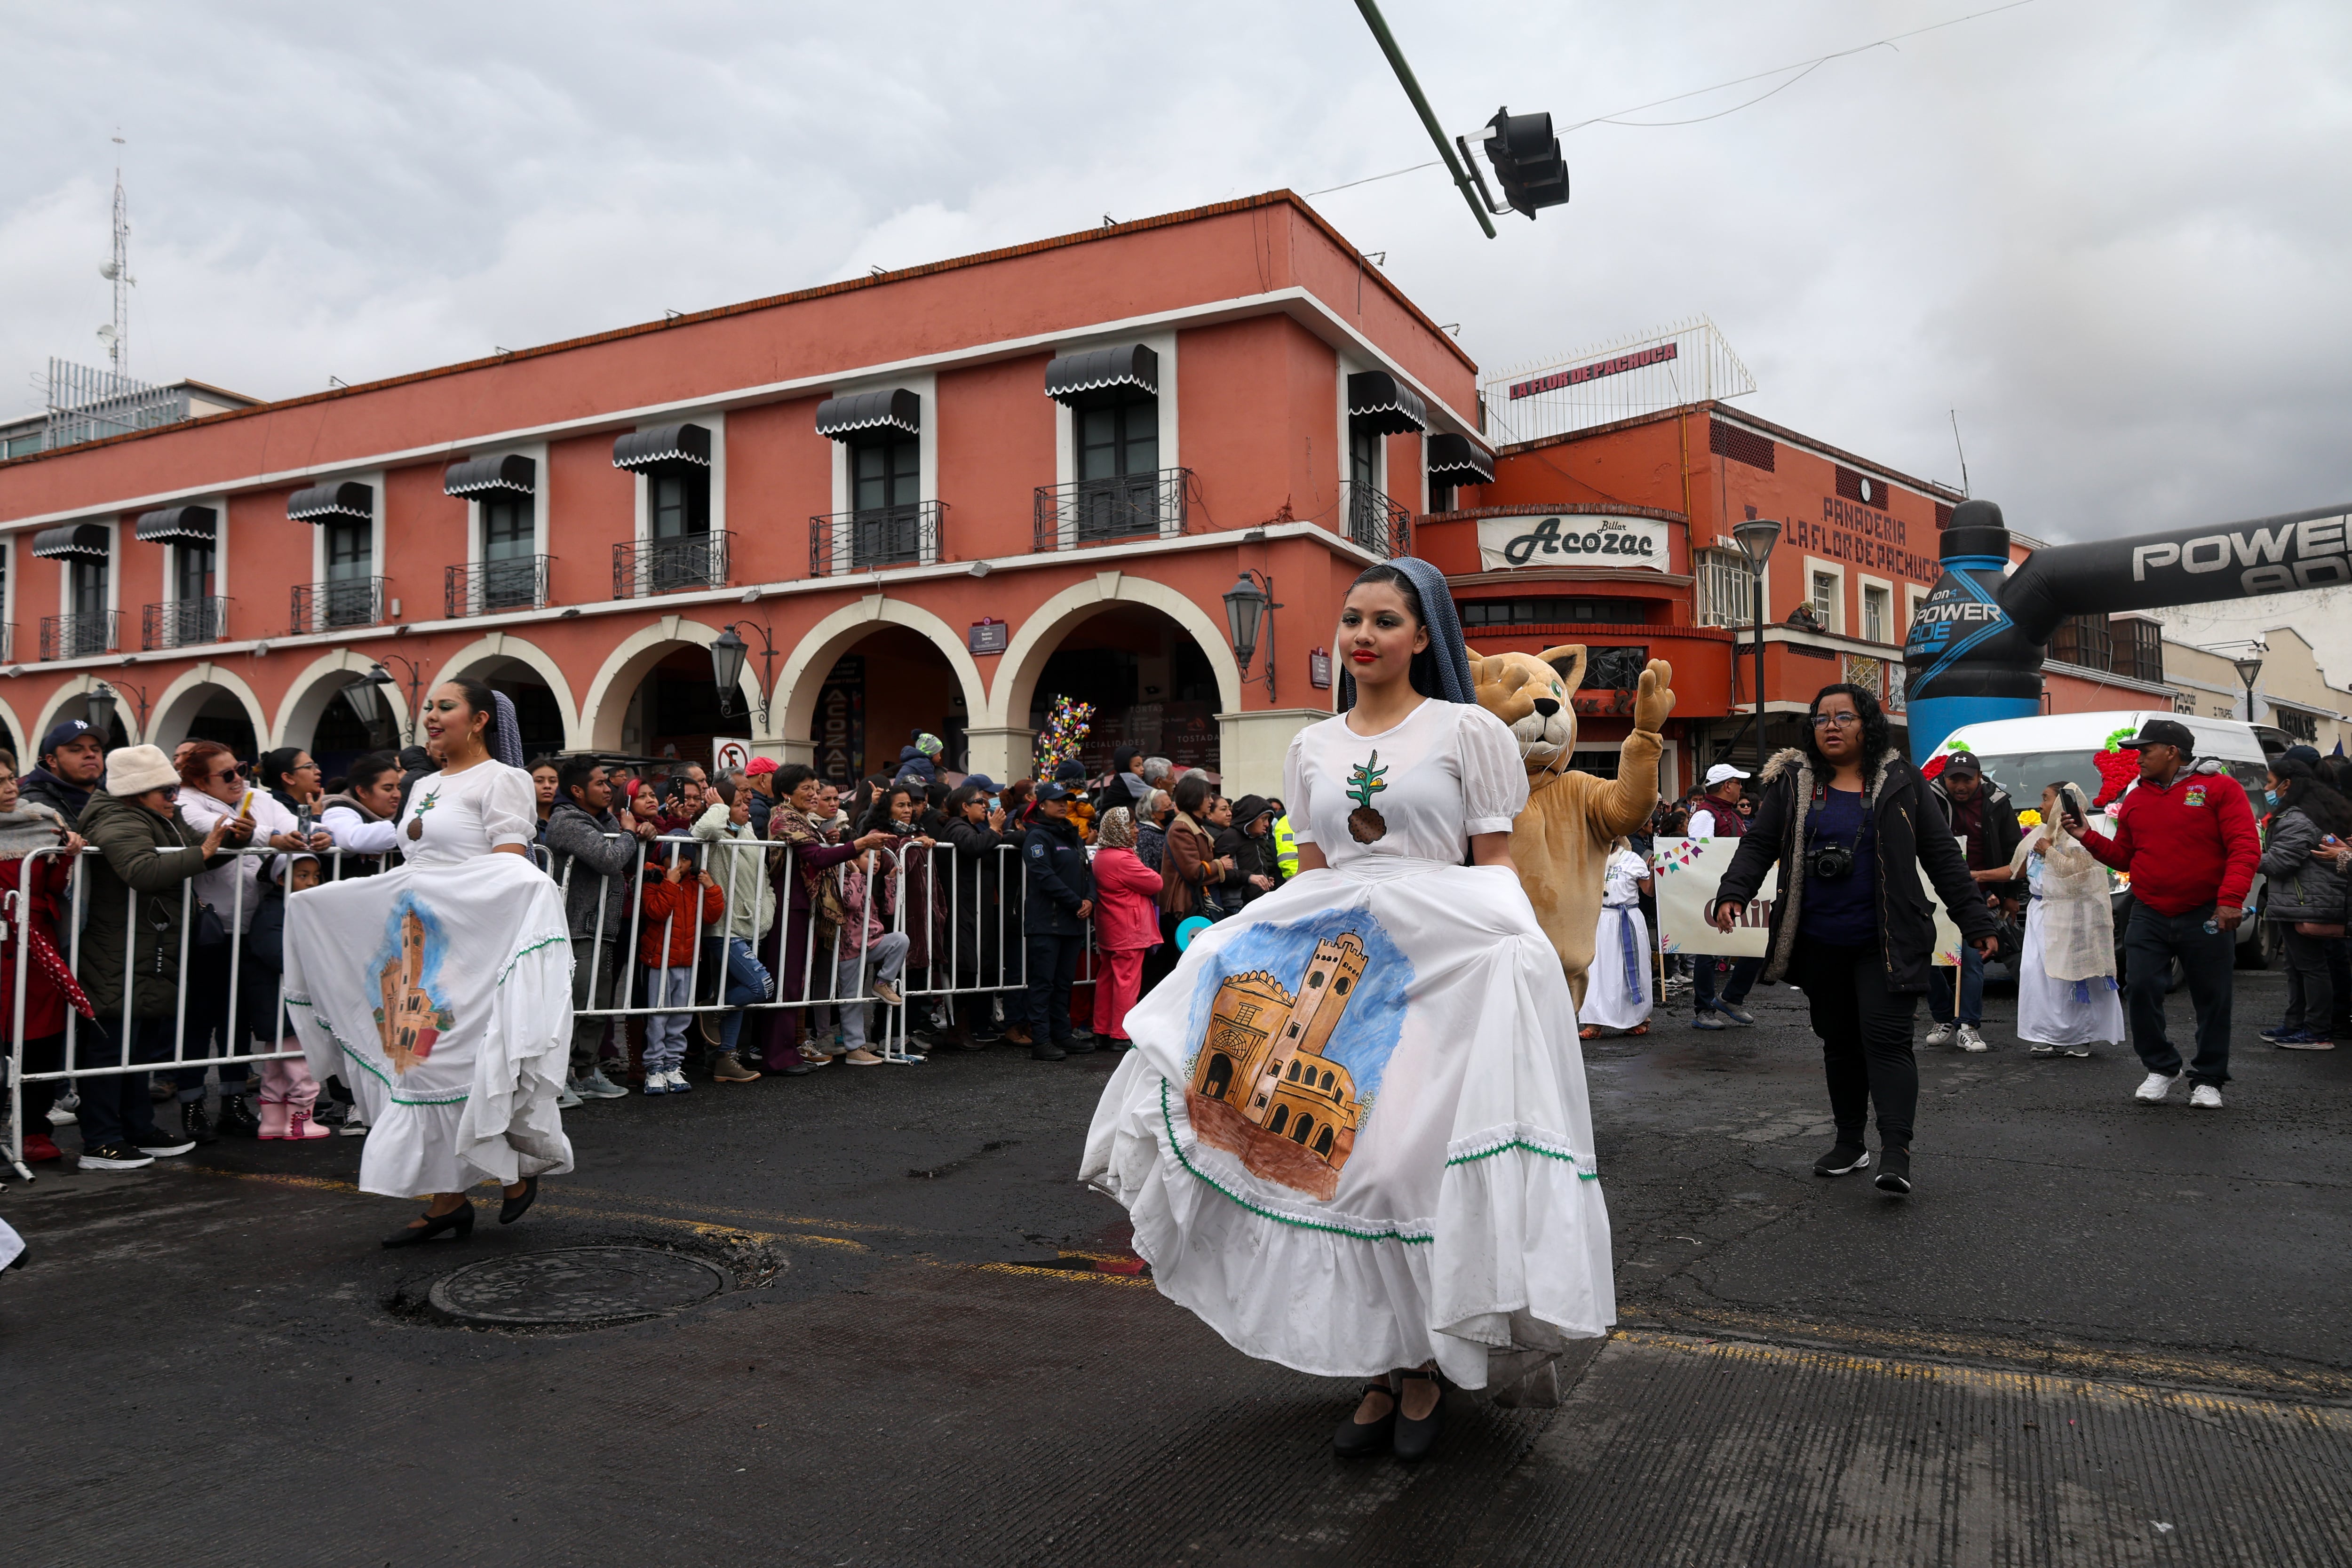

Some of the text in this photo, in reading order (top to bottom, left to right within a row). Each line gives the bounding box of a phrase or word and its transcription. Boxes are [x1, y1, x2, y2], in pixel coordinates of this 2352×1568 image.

[1510, 343, 1676, 399] LA FLOR DE PACHUCA
[1597, 520, 1627, 533] Billar
[1823, 497, 1907, 546] PANADERIA
[1505, 517, 1653, 565] Acozac
[1786, 516, 1939, 584] LA FLOR DE PACHUCA
[2132, 513, 2352, 582] POWE
[2241, 554, 2352, 596] AD
[1913, 603, 2002, 627] POWER
[1908, 621, 1952, 645] ADE
[1907, 645, 1925, 655] MORAS
[1129, 704, 1164, 713] TORTAS
[1605, 686, 1636, 714] R
[824, 688, 848, 778] ACOZAC
[1079, 739, 1145, 748] PECIALIDADES
[1177, 733, 1219, 743] TOSTADA
